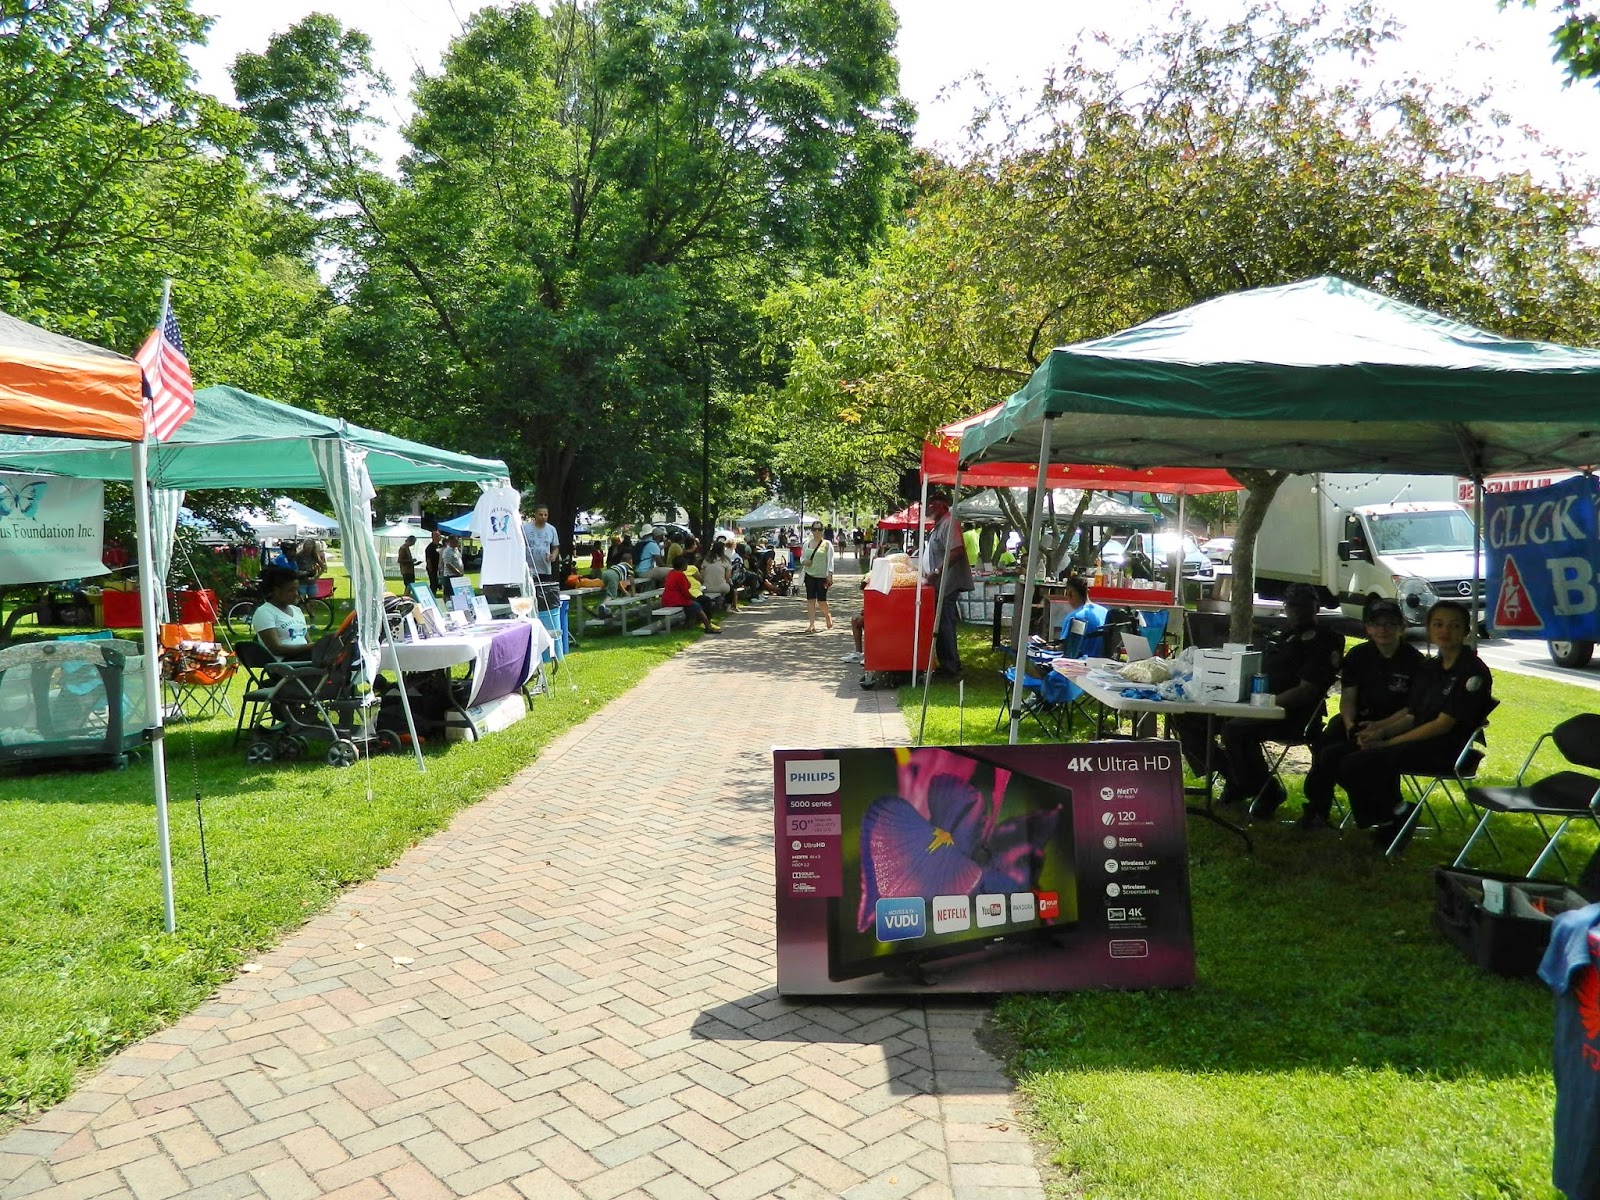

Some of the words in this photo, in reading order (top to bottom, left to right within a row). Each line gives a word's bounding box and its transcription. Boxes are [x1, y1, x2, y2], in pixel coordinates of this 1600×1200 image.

[1489, 494, 1587, 550] CLICK
[13, 523, 75, 539] Foundation
[78, 524, 95, 538] Inc.
[1067, 757, 1093, 772] 4K
[1098, 756, 1139, 772] Ultra
[1143, 755, 1171, 771] HD
[790, 772, 835, 782] PHILIPS
[1116, 787, 1139, 795] NetTV
[1117, 811, 1136, 821] 120
[1013, 903, 1034, 911] PANDORA
[1128, 907, 1142, 917] 4K
[937, 907, 967, 922] NETFLIX
[884, 914, 919, 929] VUDU
